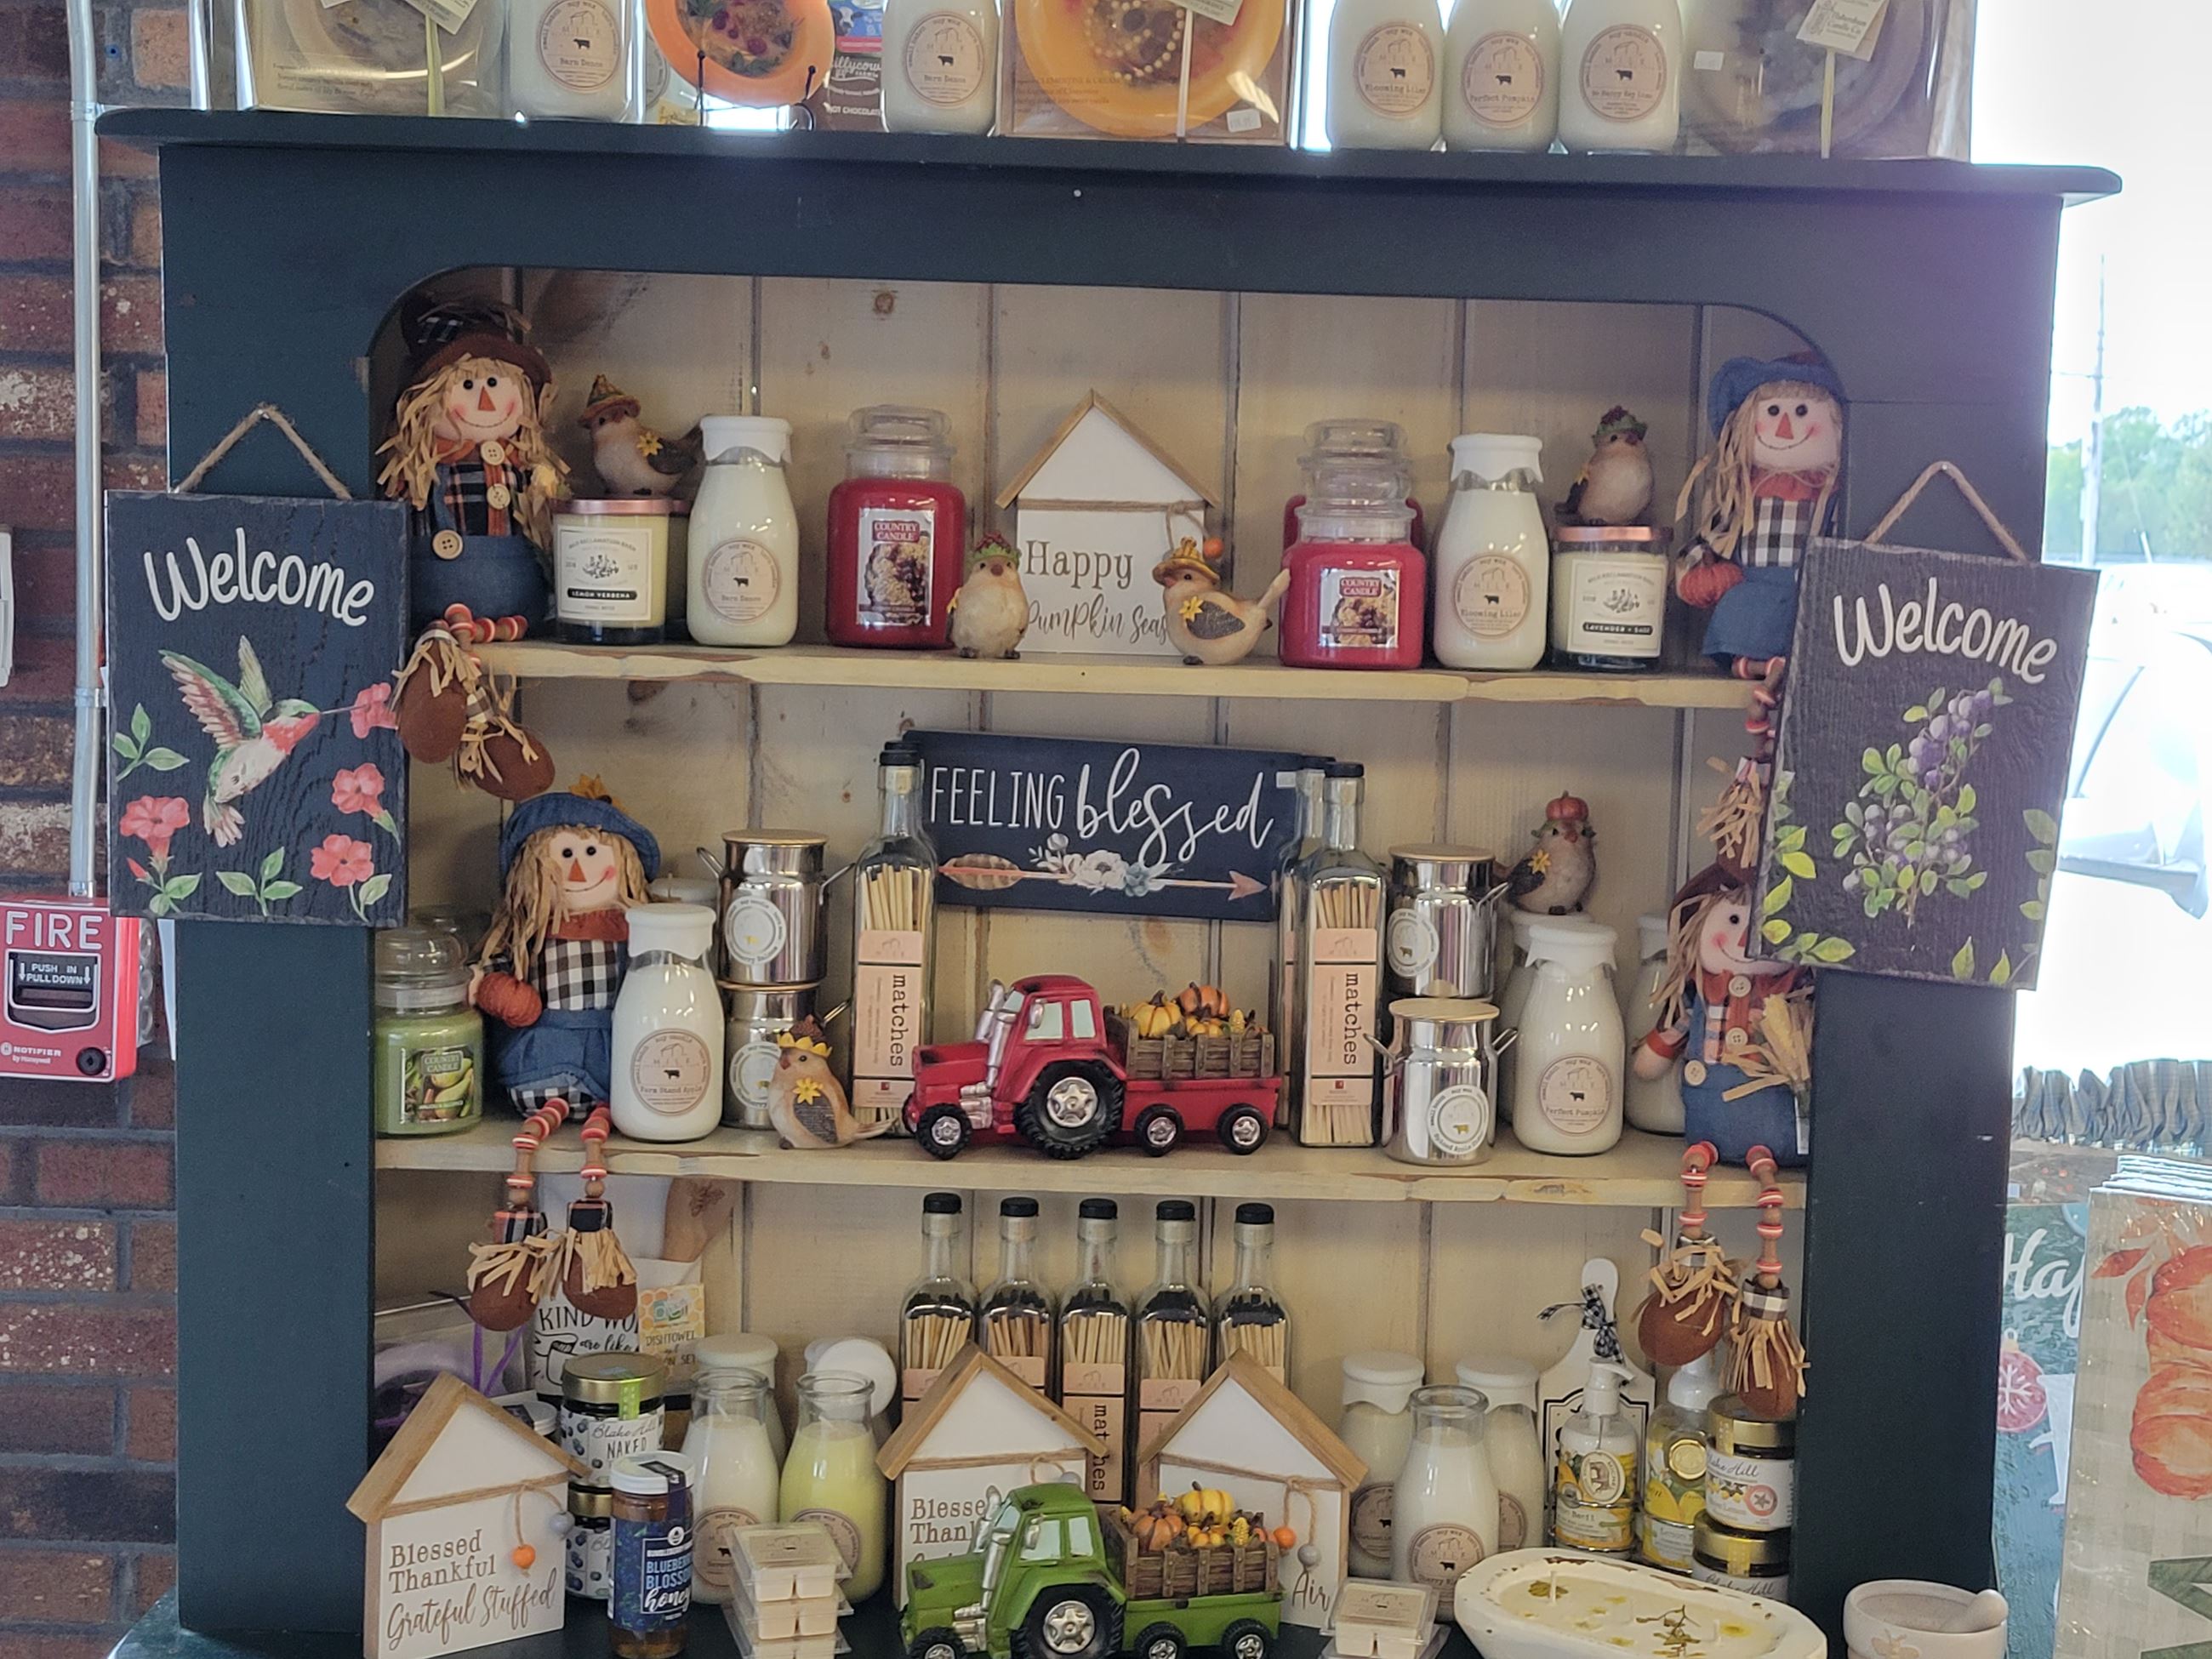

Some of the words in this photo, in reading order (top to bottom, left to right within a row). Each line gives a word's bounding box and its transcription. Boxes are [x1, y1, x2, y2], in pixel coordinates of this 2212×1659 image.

[1365, 83, 1405, 95] Blooming
[1469, 94, 1499, 103] Perfect
[874, 522, 918, 533] COUNTRY
[875, 531, 915, 541] CANDLE
[1024, 539, 1133, 590] Happy
[143, 526, 375, 627] Welcome
[1340, 579, 1381, 588] COUNTRY
[1343, 587, 1379, 596] CANDLE
[1833, 576, 2058, 685] Welcome
[930, 767, 1066, 830] FEELING
[1075, 747, 1274, 869] blessed
[6, 910, 103, 950] FIRE
[26, 972, 52, 983] PULL
[52, 972, 83, 985] DOWN
[31, 963, 58, 973] PUSH
[66, 964, 77, 974] IN
[890, 973, 909, 1067] matches
[1343, 972, 1365, 1065] matches
[13, 1046, 62, 1057] NOTIFIER
[425, 1054, 460, 1065] COUNTRY
[426, 1063, 459, 1074] CANDLE
[646, 1330, 696, 1348] DISHTOWEL
[910, 1498, 986, 1520] Blesse
[389, 1529, 482, 1569] Blessed
[388, 1554, 497, 1594] Thankful
[644, 1586, 691, 1613] honey
[1291, 1570, 1331, 1614] Air
[387, 1582, 476, 1651] Grateful
[480, 1567, 557, 1631] Stuffed
